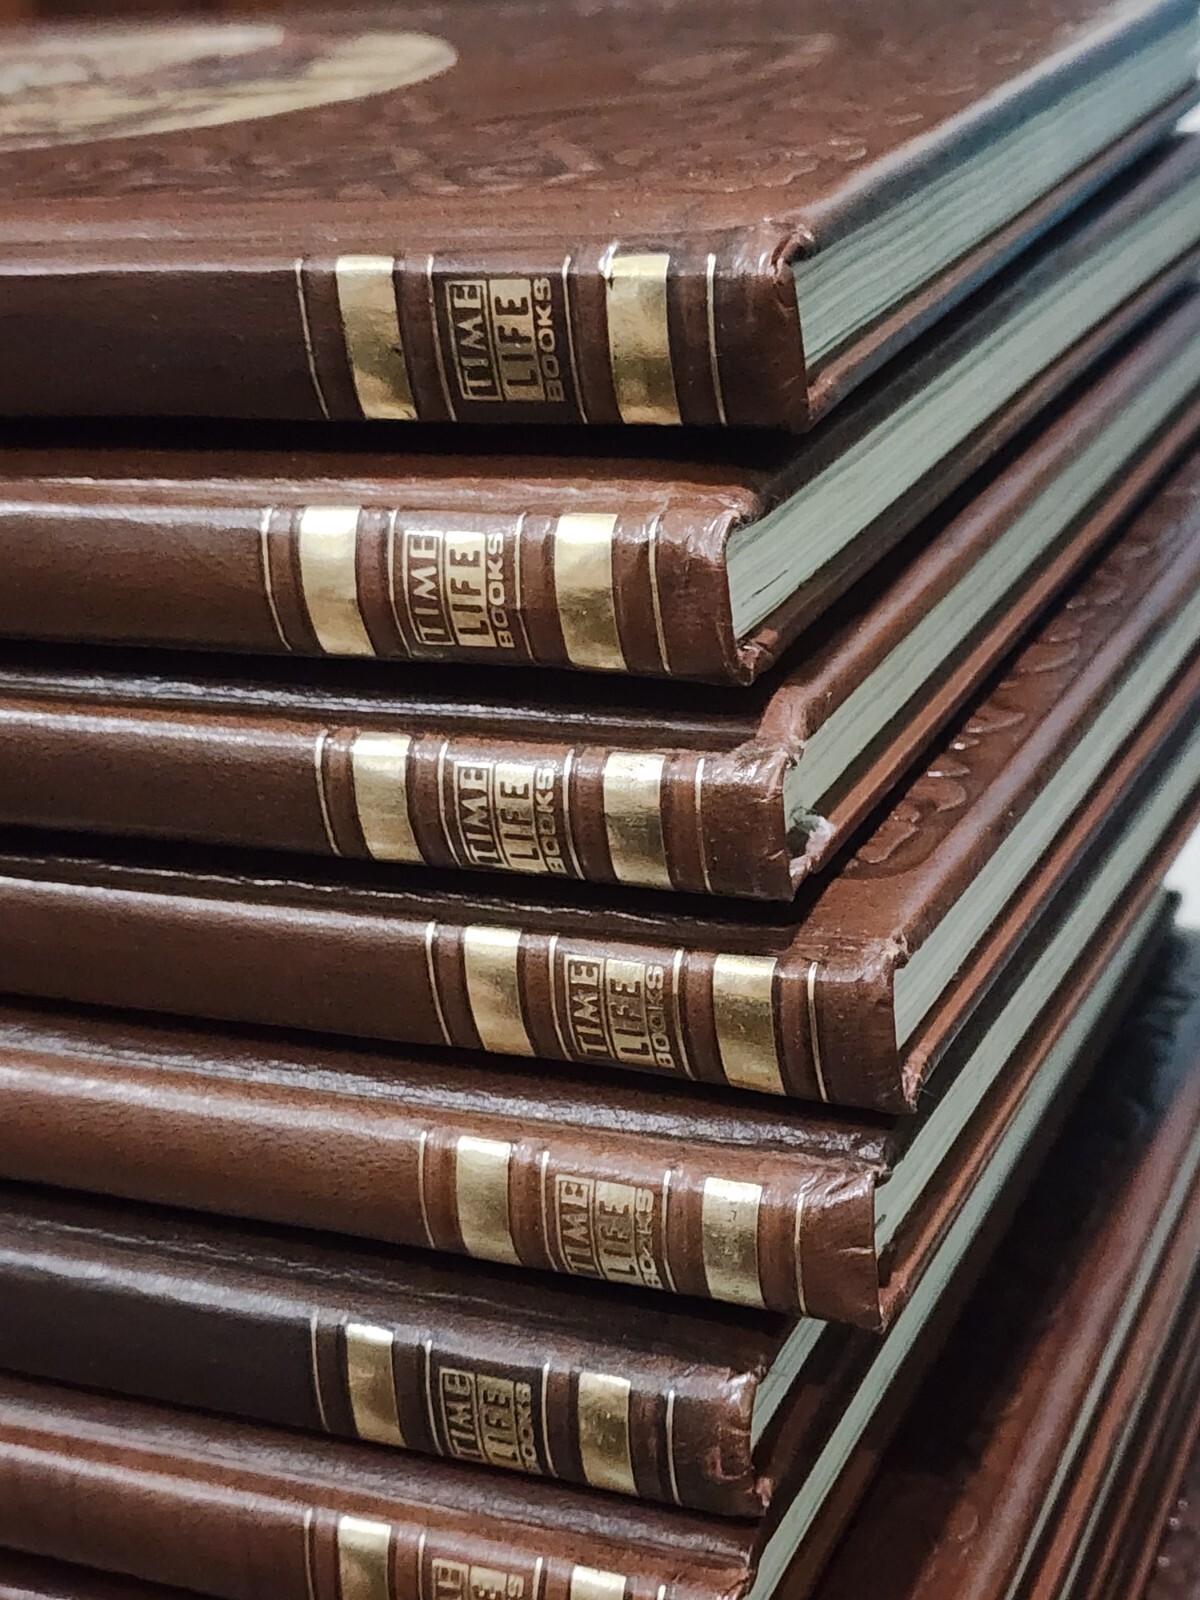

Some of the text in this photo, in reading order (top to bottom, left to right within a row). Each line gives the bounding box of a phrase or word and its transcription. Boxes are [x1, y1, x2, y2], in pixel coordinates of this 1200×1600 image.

[452, 285, 494, 397] TIME
[494, 295, 541, 387] LIFE
[533, 277, 565, 401] BOOKS
[410, 535, 446, 641] TIME
[448, 548, 492, 636] LIFE
[487, 532, 515, 648] BOOKS
[460, 767, 500, 863] TIME
[499, 780, 541, 861] LIFE
[534, 767, 568, 873] BOOKS
[570, 964, 608, 1056] TIME
[608, 977, 651, 1057] LIFE
[646, 965, 676, 1069] BOOKS
[560, 1181, 597, 1272] TIME
[598, 1199, 637, 1277] LIFE
[444, 1374, 481, 1457] TIME
[482, 1388, 519, 1462] LIFE
